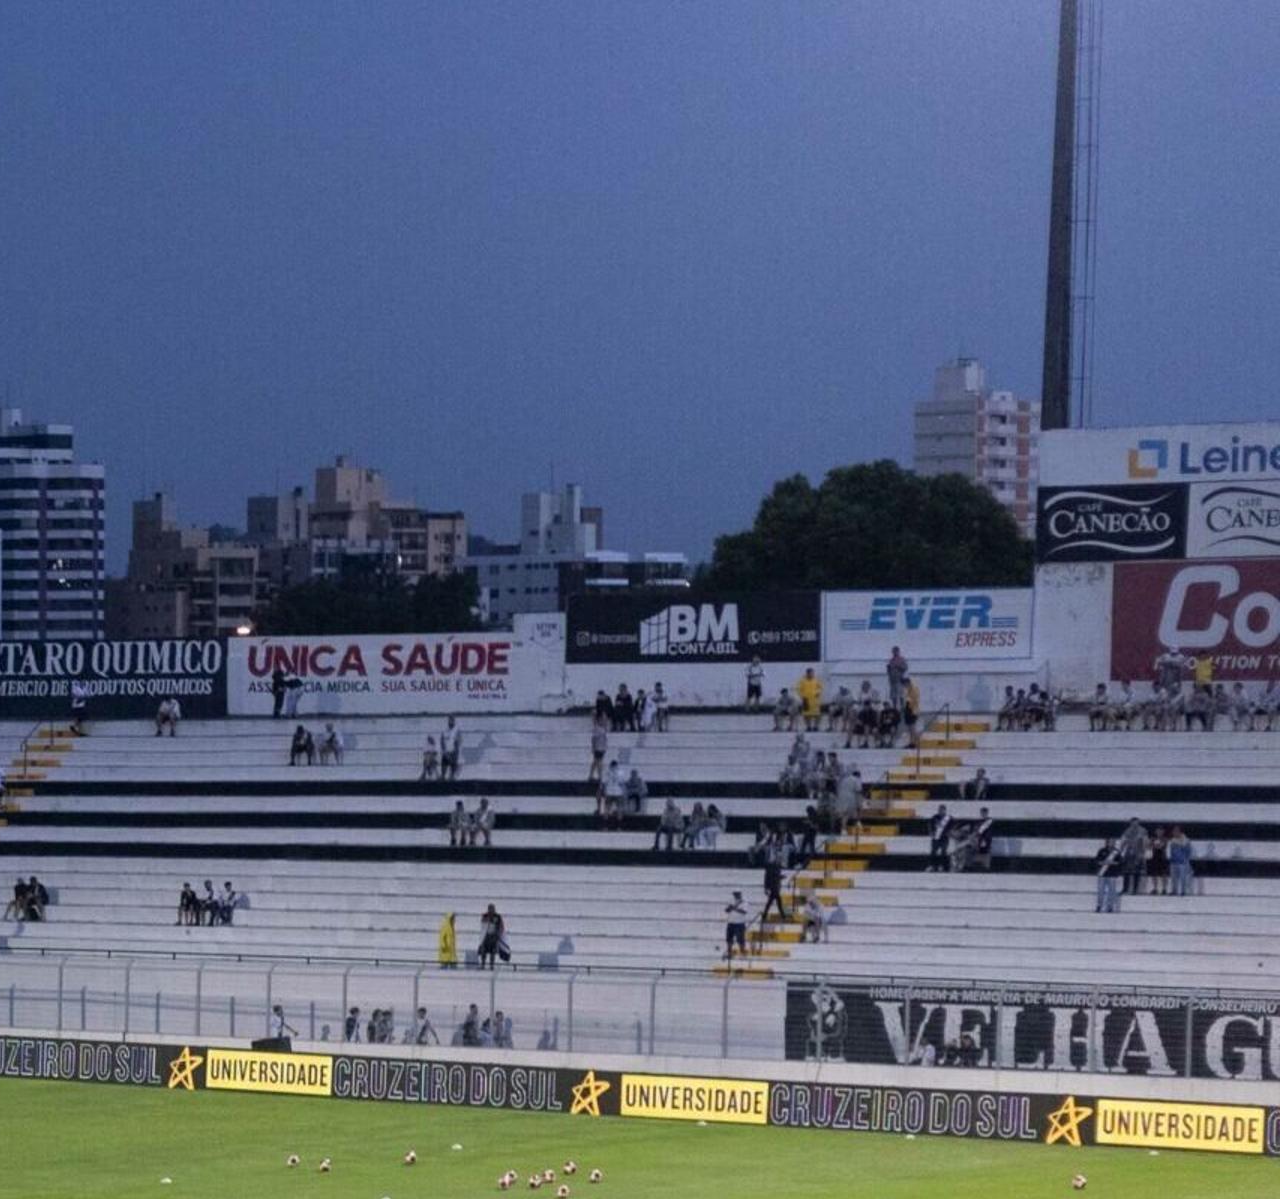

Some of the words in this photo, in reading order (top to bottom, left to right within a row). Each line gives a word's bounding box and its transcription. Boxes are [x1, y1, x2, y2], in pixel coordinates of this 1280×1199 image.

[668, 602, 739, 642] BM
[868, 595, 993, 631] EVER
[247, 638, 368, 678] ÚNICA
[380, 634, 512, 677] SAÚDE
[954, 630, 1017, 648] EXPRESS
[50, 679, 70, 697] DE
[380, 679, 406, 693] SUA
[874, 1000, 1178, 1076] VELHA
[79, 1041, 112, 1081] DO
[114, 1044, 161, 1084] SUL
[210, 1058, 329, 1088] UNIVERSIDADE
[334, 1057, 466, 1104] CRUZEIRO
[470, 1065, 508, 1107] DO
[510, 1068, 563, 1110] SUL
[625, 1083, 763, 1115] UNIVERSIDADE
[769, 1082, 923, 1133] CRUZEIRO
[928, 1091, 970, 1136] DO
[975, 1094, 1038, 1140] SUL
[1102, 1109, 1259, 1144] UNIVERSIDADE
